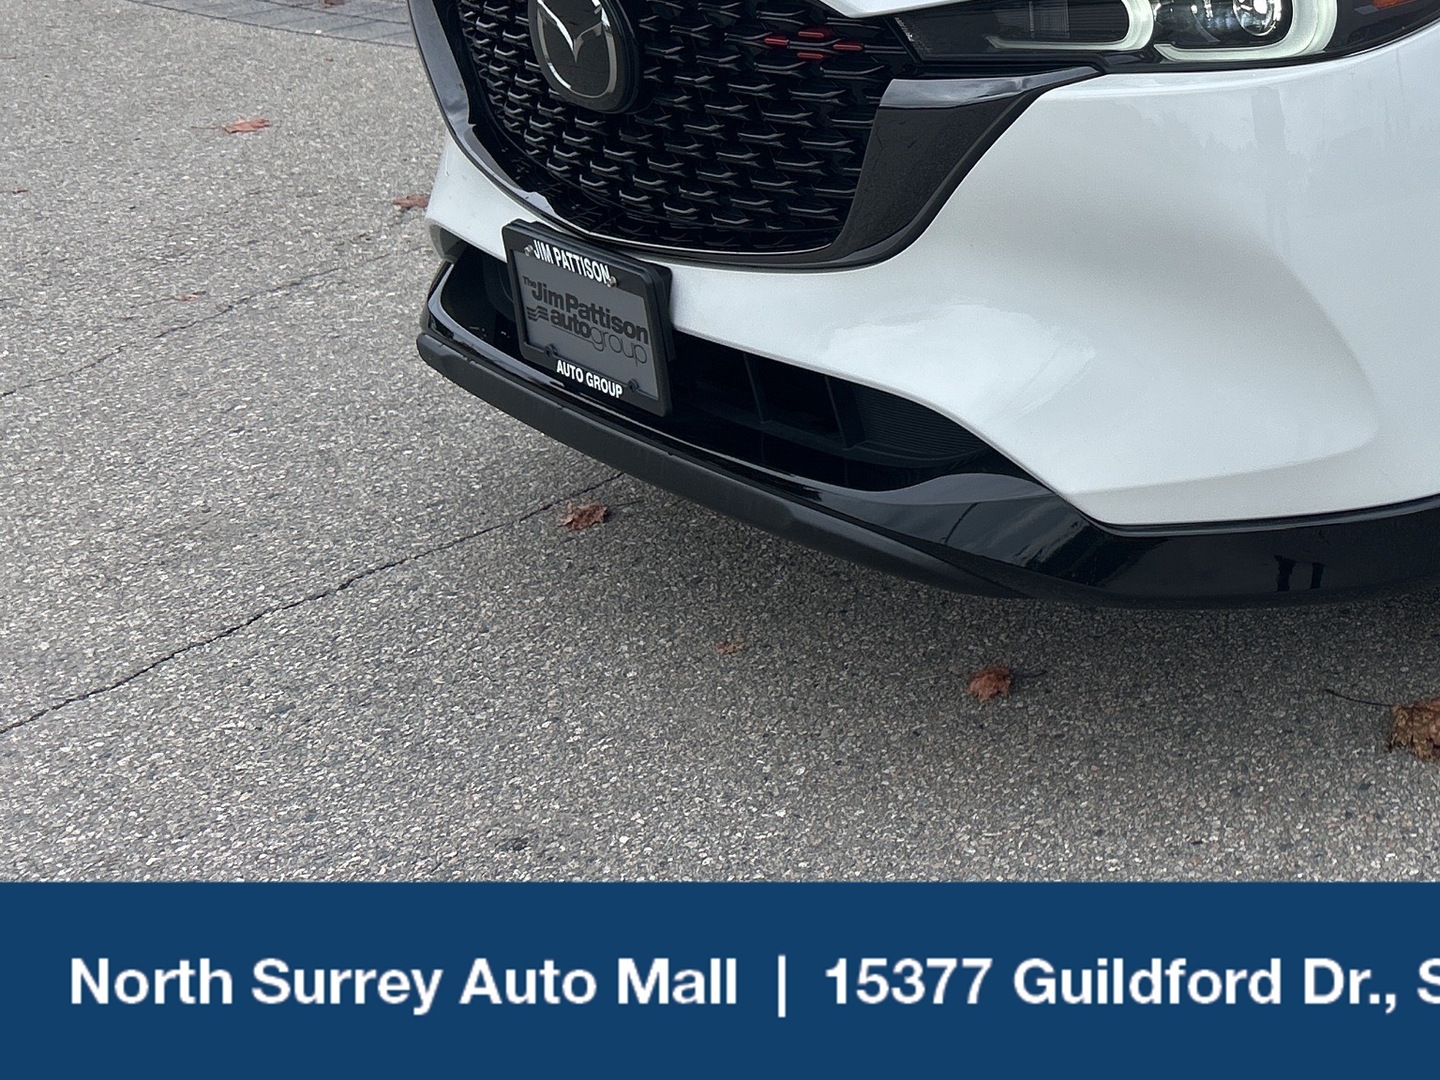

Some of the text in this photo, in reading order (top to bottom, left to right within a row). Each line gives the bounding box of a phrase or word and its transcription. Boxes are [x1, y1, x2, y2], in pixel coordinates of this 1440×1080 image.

[522, 275, 537, 290] The
[532, 239, 612, 285] JIM PATTISON
[532, 281, 650, 345] Jim Pattison
[556, 359, 624, 399] AUTO GROUP
